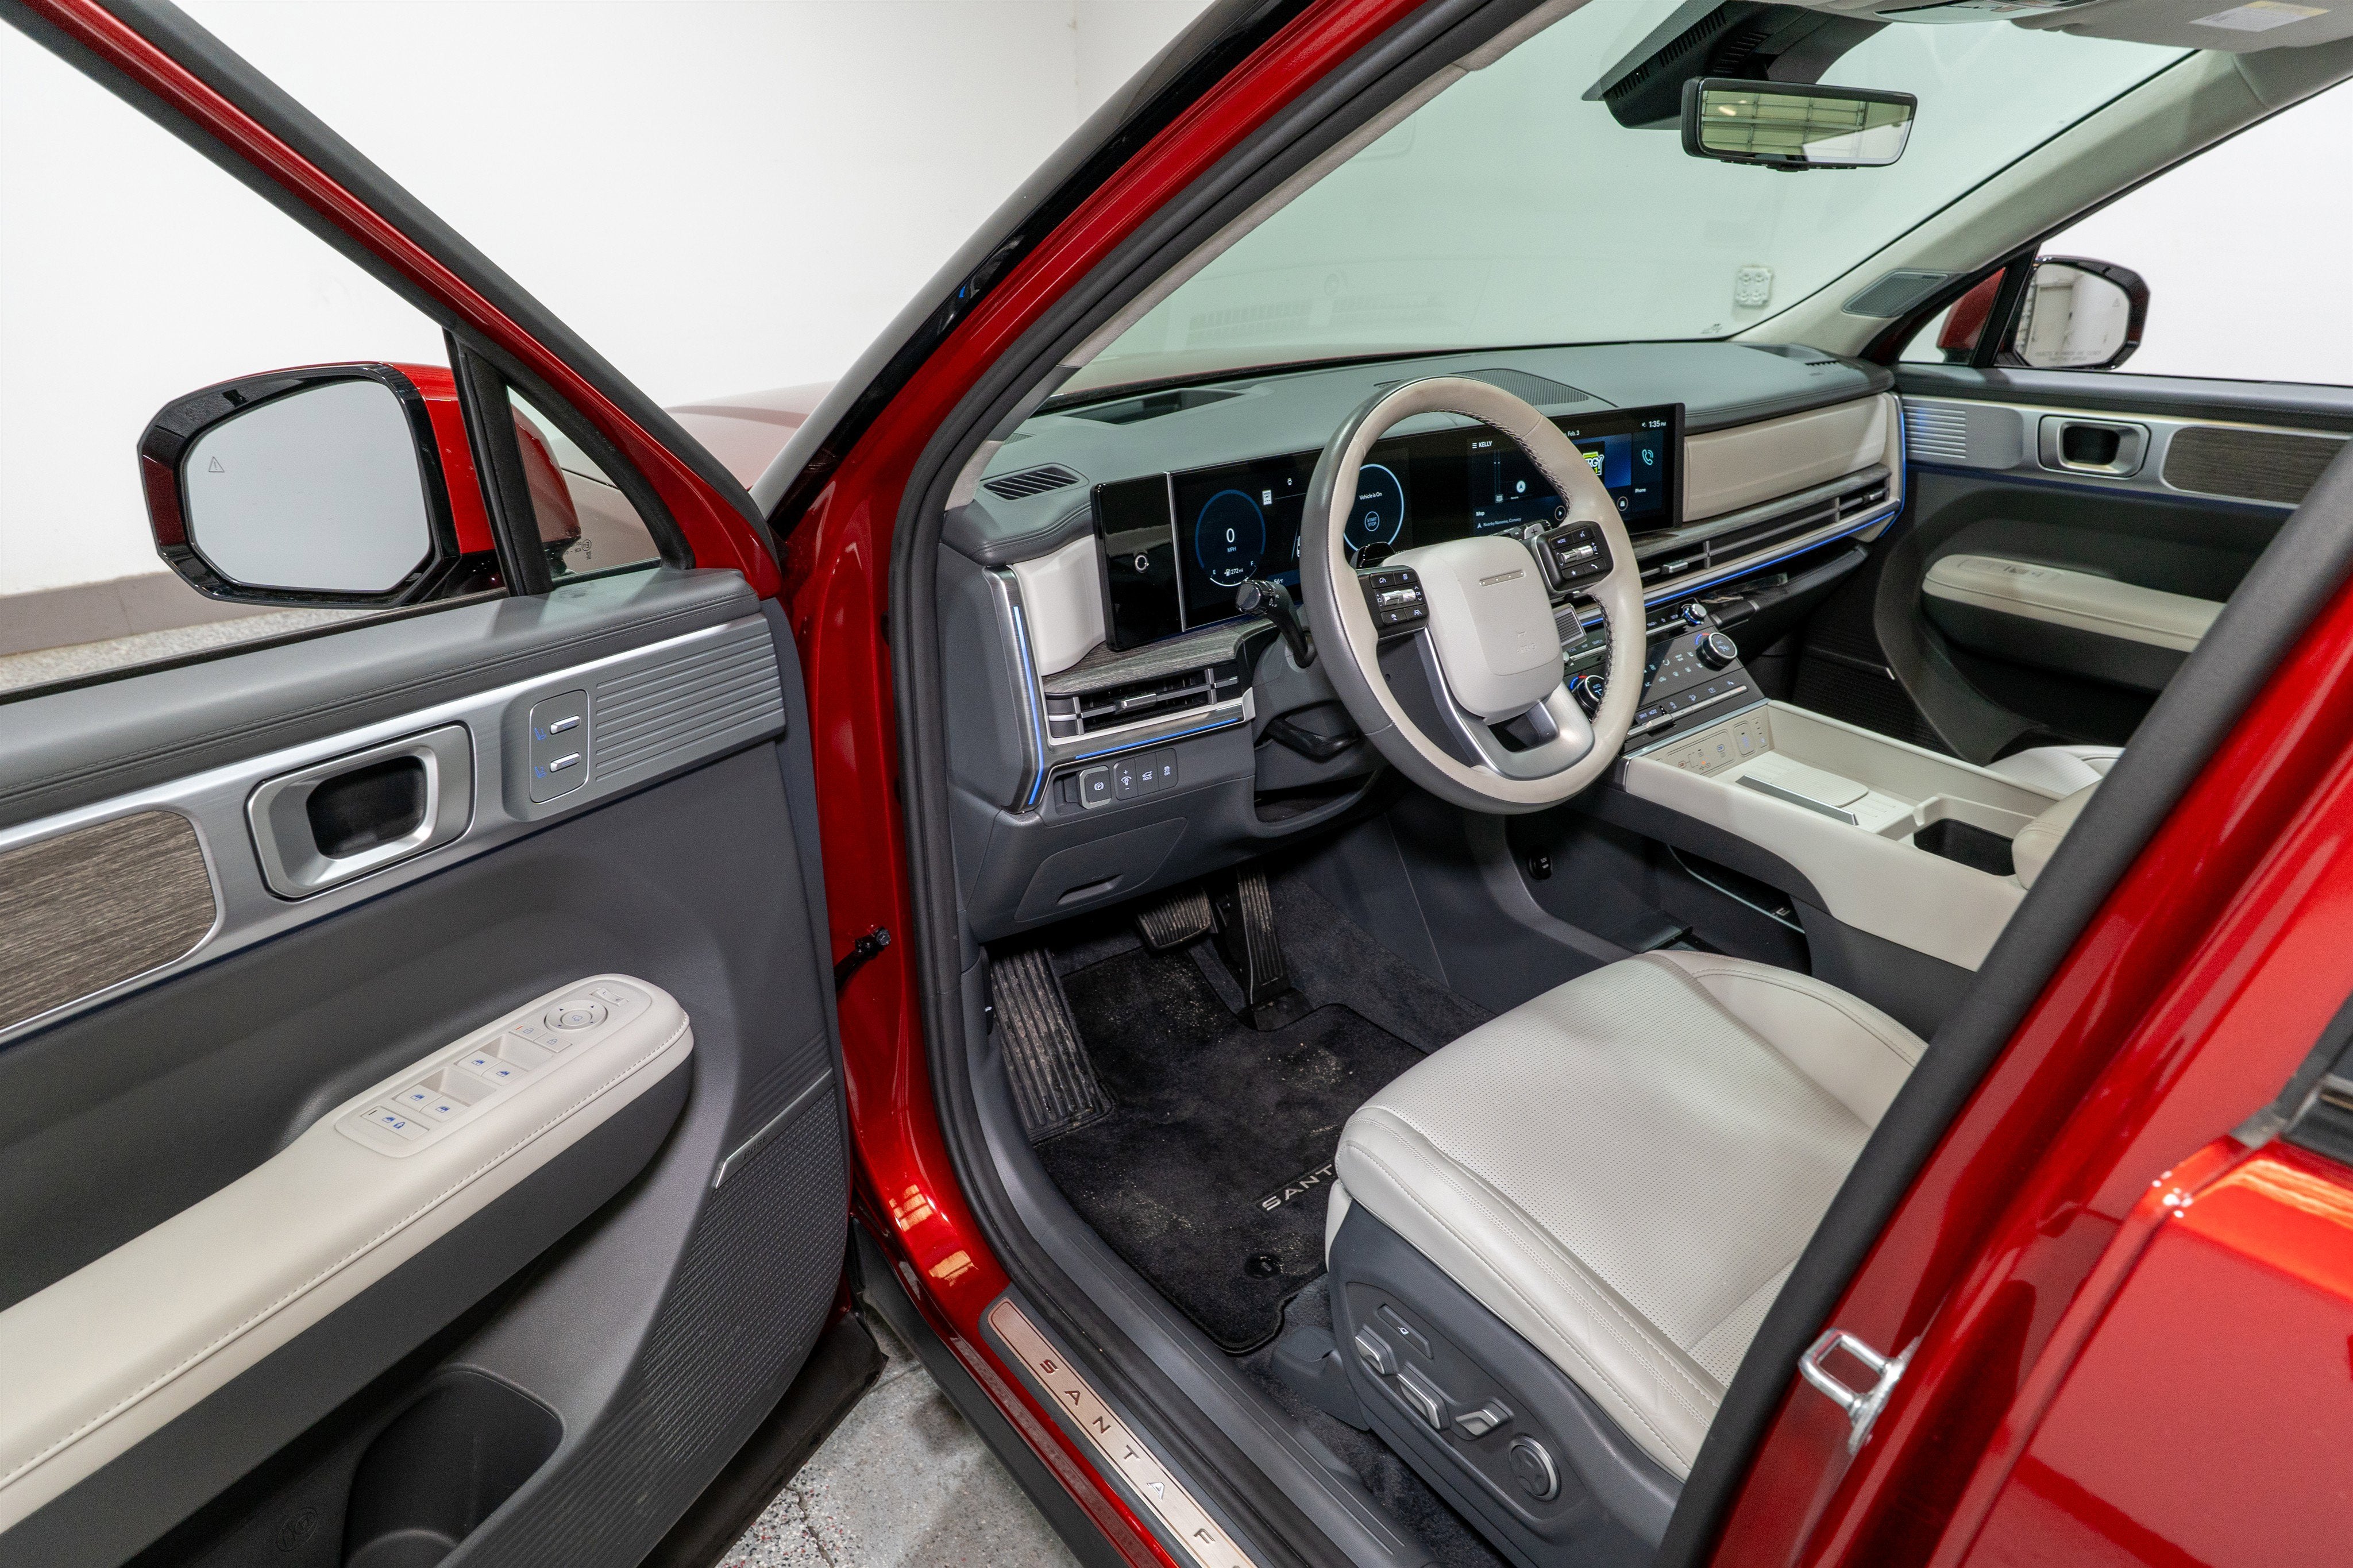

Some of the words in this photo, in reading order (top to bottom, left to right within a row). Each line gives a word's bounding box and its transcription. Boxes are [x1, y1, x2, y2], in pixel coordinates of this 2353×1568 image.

[1226, 528, 1235, 543] 0
[1262, 1164, 1332, 1211] SANT
[1039, 1360, 1167, 1501] SANTA
